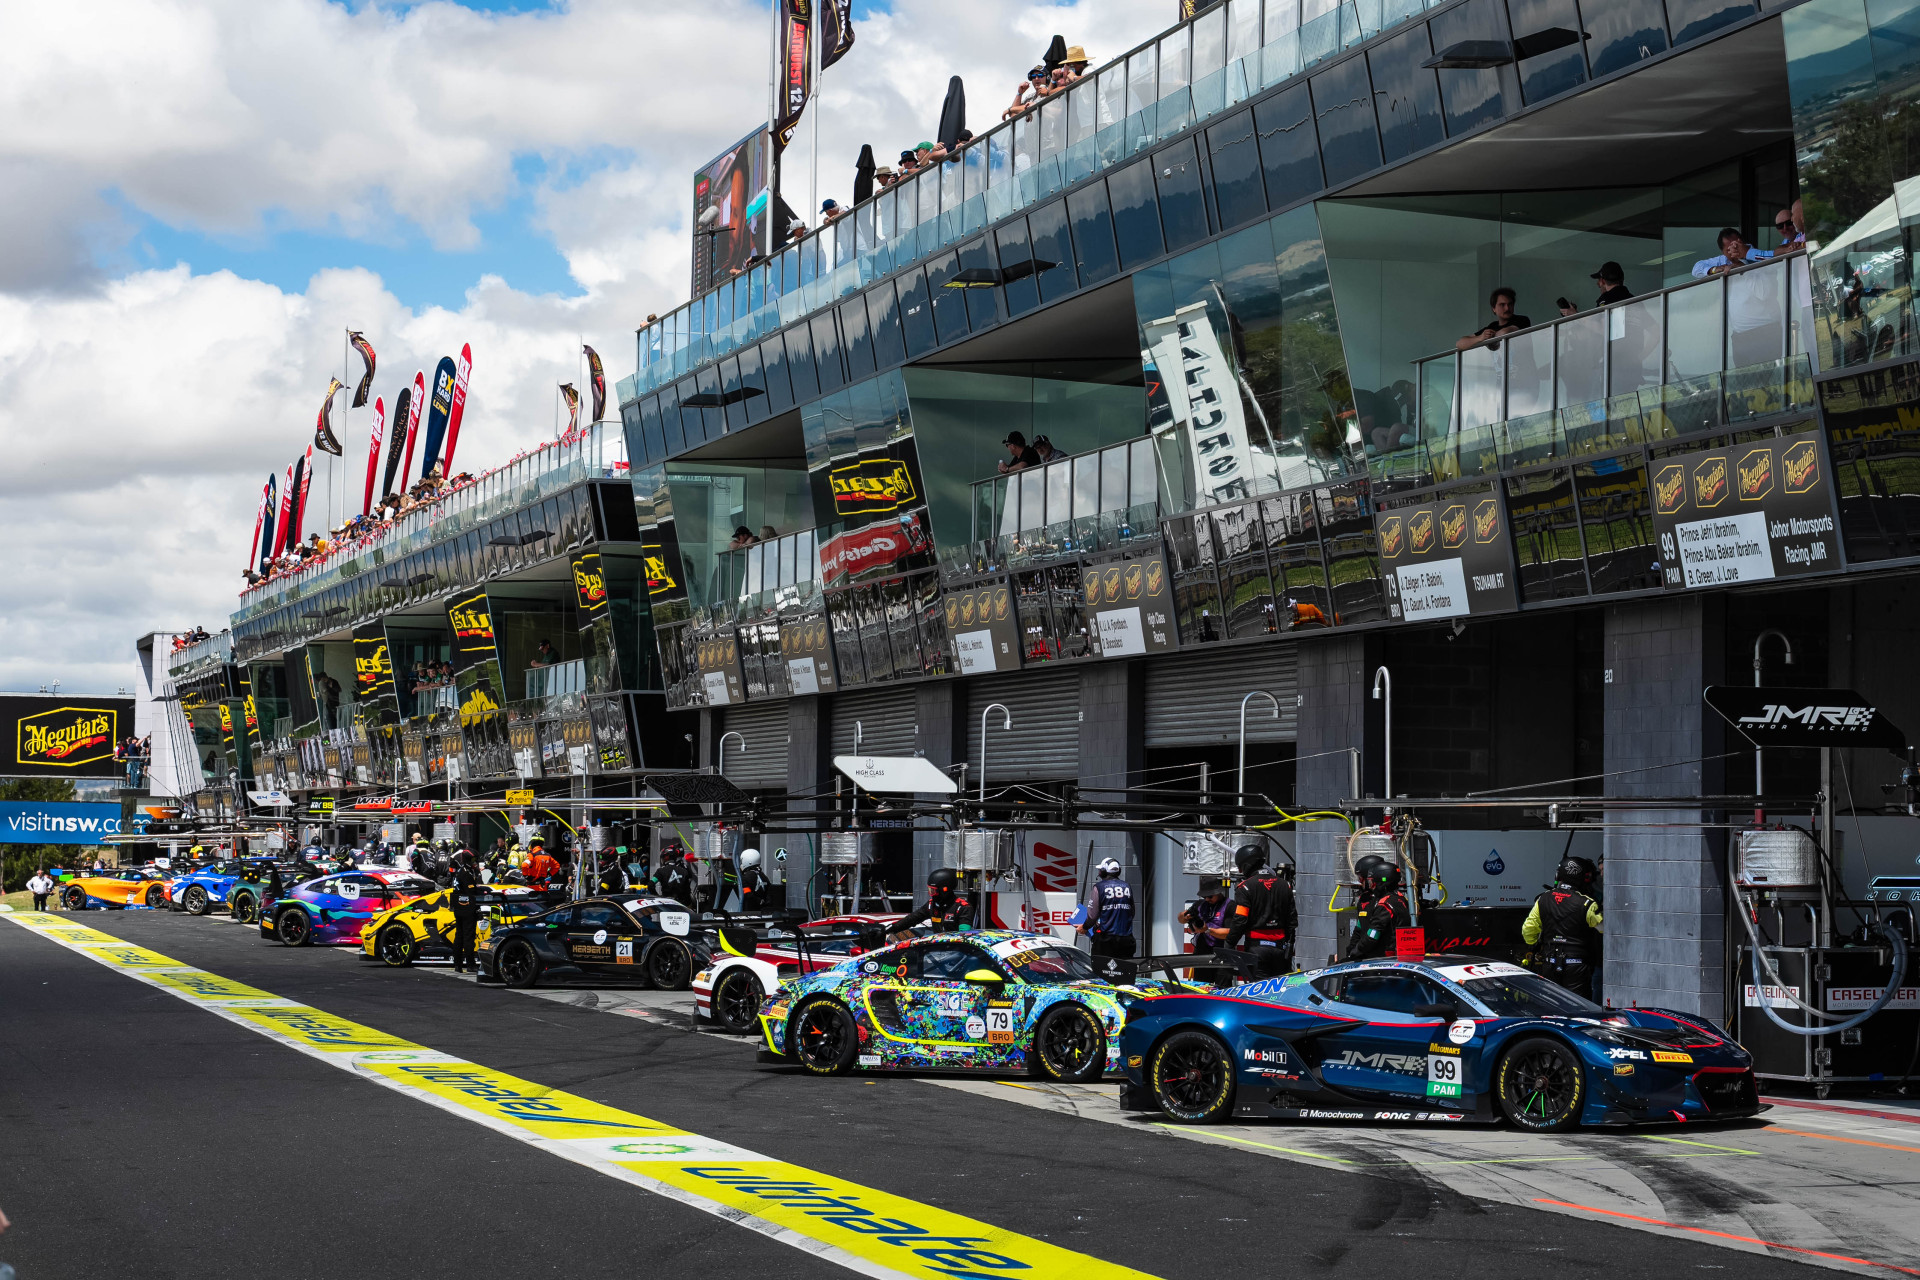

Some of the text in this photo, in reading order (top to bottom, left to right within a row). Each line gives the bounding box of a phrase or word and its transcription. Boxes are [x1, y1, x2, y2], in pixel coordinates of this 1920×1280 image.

[790, 22, 805, 103] BATHURST 12
[1680, 526, 1700, 543] Prince
[1770, 514, 1833, 539] Johor Motorsports
[1661, 532, 1676, 560] 99
[1684, 548, 1704, 564] Prince
[1705, 546, 1716, 561] Abu
[1717, 545, 1735, 560] Bakar
[1784, 541, 1827, 566] Racing JMR
[1385, 573, 1397, 597] 79
[1666, 567, 1682, 584] PAM
[1688, 566, 1739, 585] B. Green, J. Love
[1738, 704, 1849, 725] JMR
[25, 714, 110, 756] Meguiar's
[1104, 887, 1131, 899] 384
[573, 945, 611, 955] HERBERTH
[619, 944, 629, 955] 21
[1832, 989, 1917, 1001] CASELIER
[991, 1012, 1008, 1029] 79
[1244, 1049, 1275, 1062] Mobil
[1429, 1043, 1461, 1055] MEGUIAR'S
[1609, 1047, 1648, 1060] XPEL
[1655, 1053, 1690, 1061] PIRELLI
[1155, 1048, 1166, 1093] PIRELLI
[1322, 1051, 1408, 1071] JMR
[1434, 1060, 1456, 1080] 99
[1376, 1068, 1423, 1076] RACING
[1500, 1060, 1508, 1099] PIRELLI
[397, 1065, 564, 1112] ultimate
[1217, 1072, 1231, 1108] ZERO
[1433, 1084, 1456, 1096] PAM
[1570, 1075, 1580, 1109] ZERO
[1310, 1110, 1364, 1119] Monochrome
[680, 1166, 1033, 1271] ultimate
